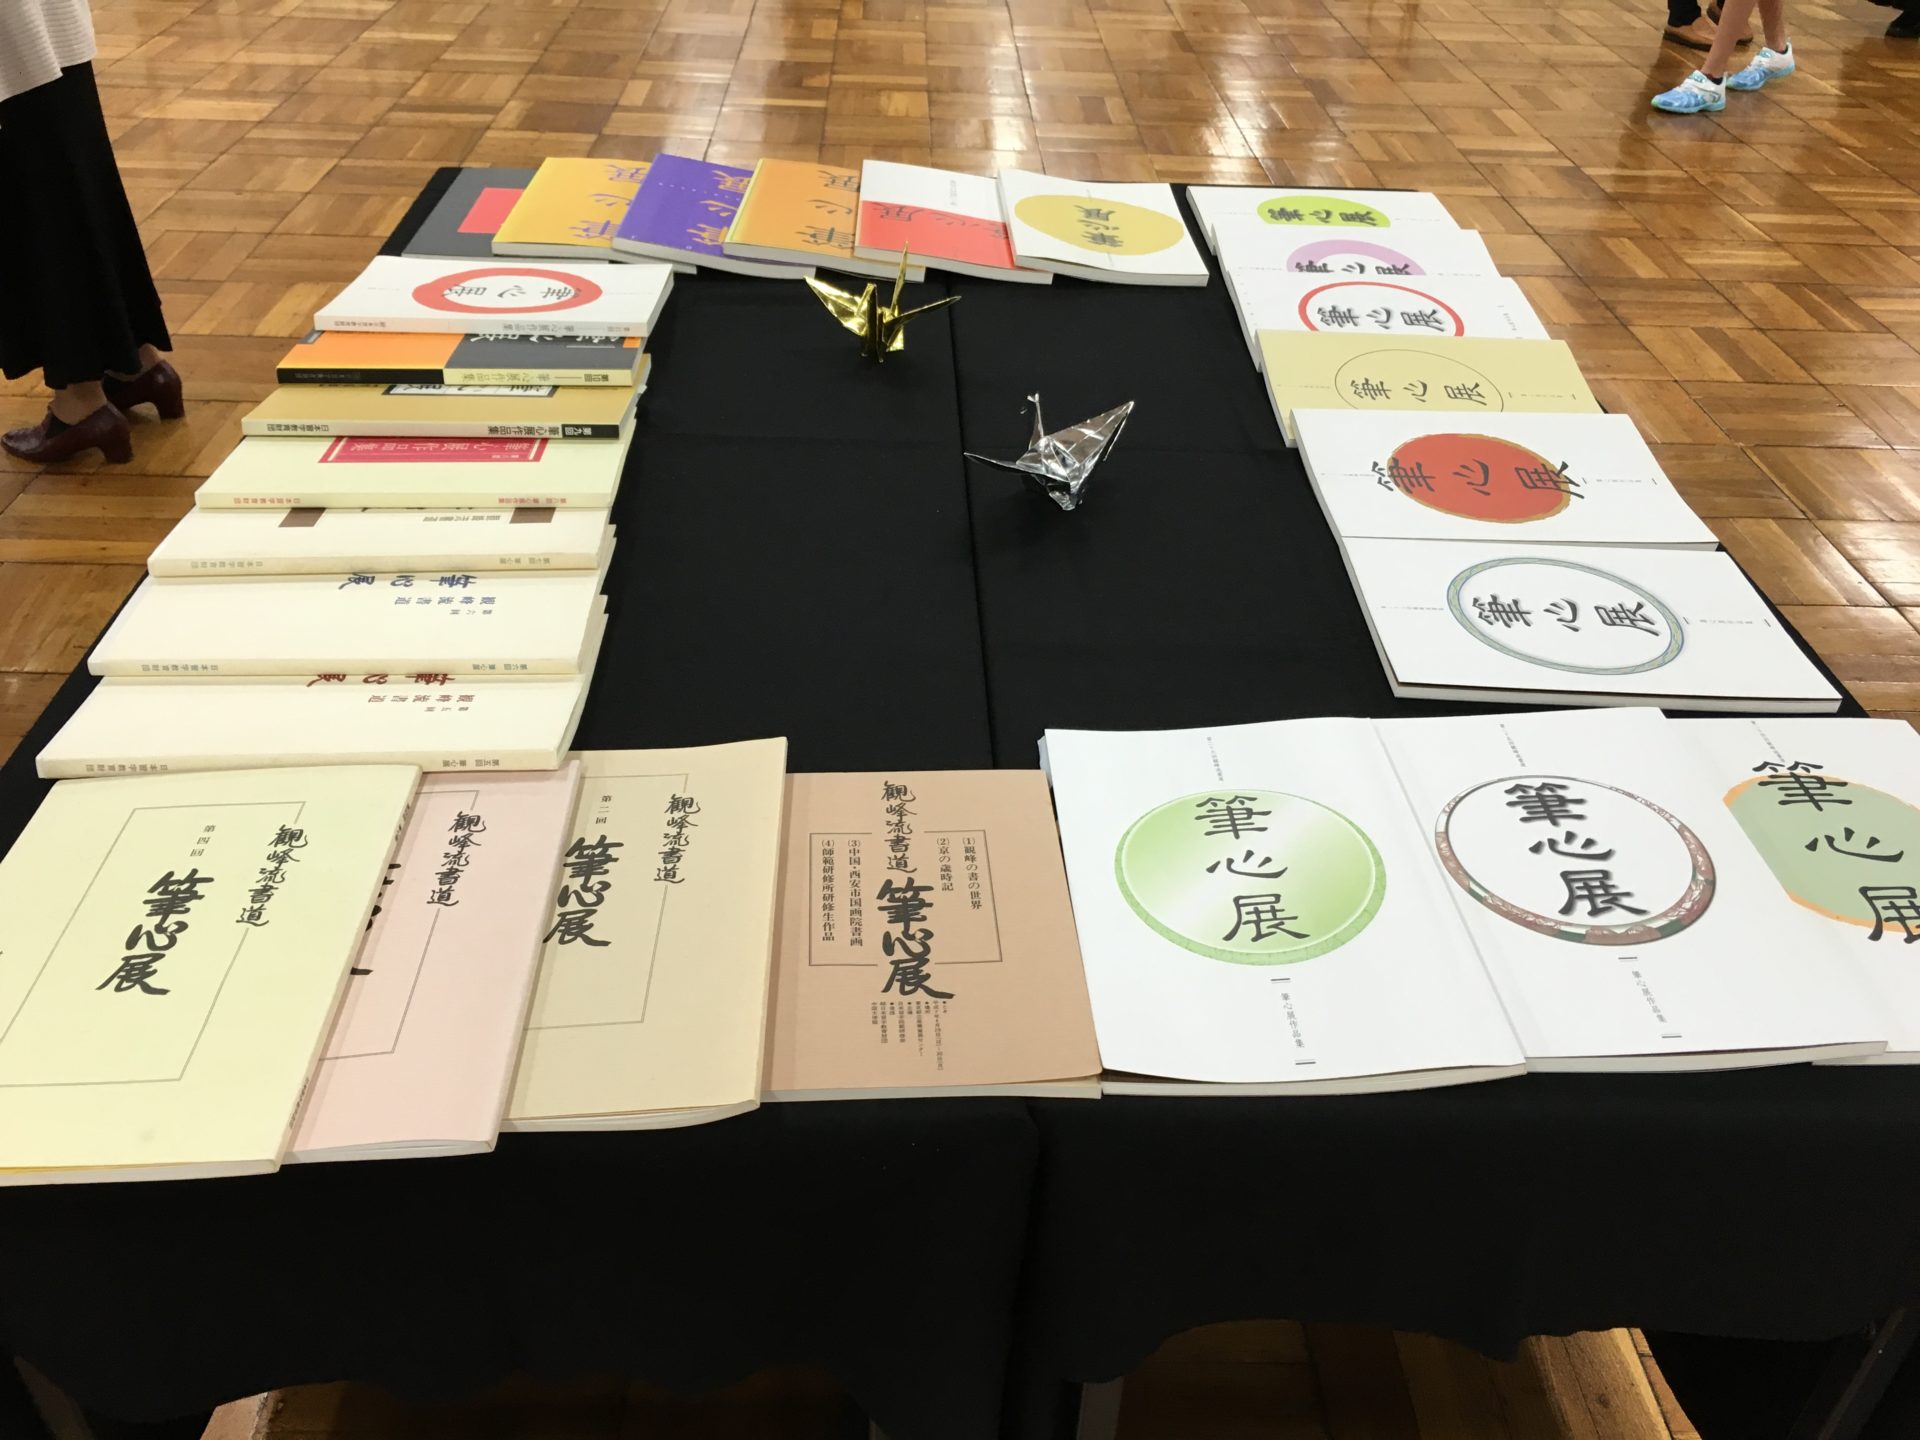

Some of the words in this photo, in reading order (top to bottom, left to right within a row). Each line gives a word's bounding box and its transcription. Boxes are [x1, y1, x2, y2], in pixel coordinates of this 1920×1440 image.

[1316, 304, 1448, 333] 筆心展
[1349, 376, 1490, 407] 筆心展
[1371, 456, 1586, 501] 筆心展
[1471, 593, 1661, 637] 筆心展
[595, 795, 612, 825] 第二回
[190, 824, 217, 858] 第四回
[1503, 780, 1652, 918] 筆心展
[542, 834, 625, 948] 筆心展
[1194, 794, 1311, 943] 筆心展
[95, 867, 215, 997] 筆心展
[876, 876, 956, 1000] 筆心展
[1280, 992, 1306, 1049] 筆心展作品集
